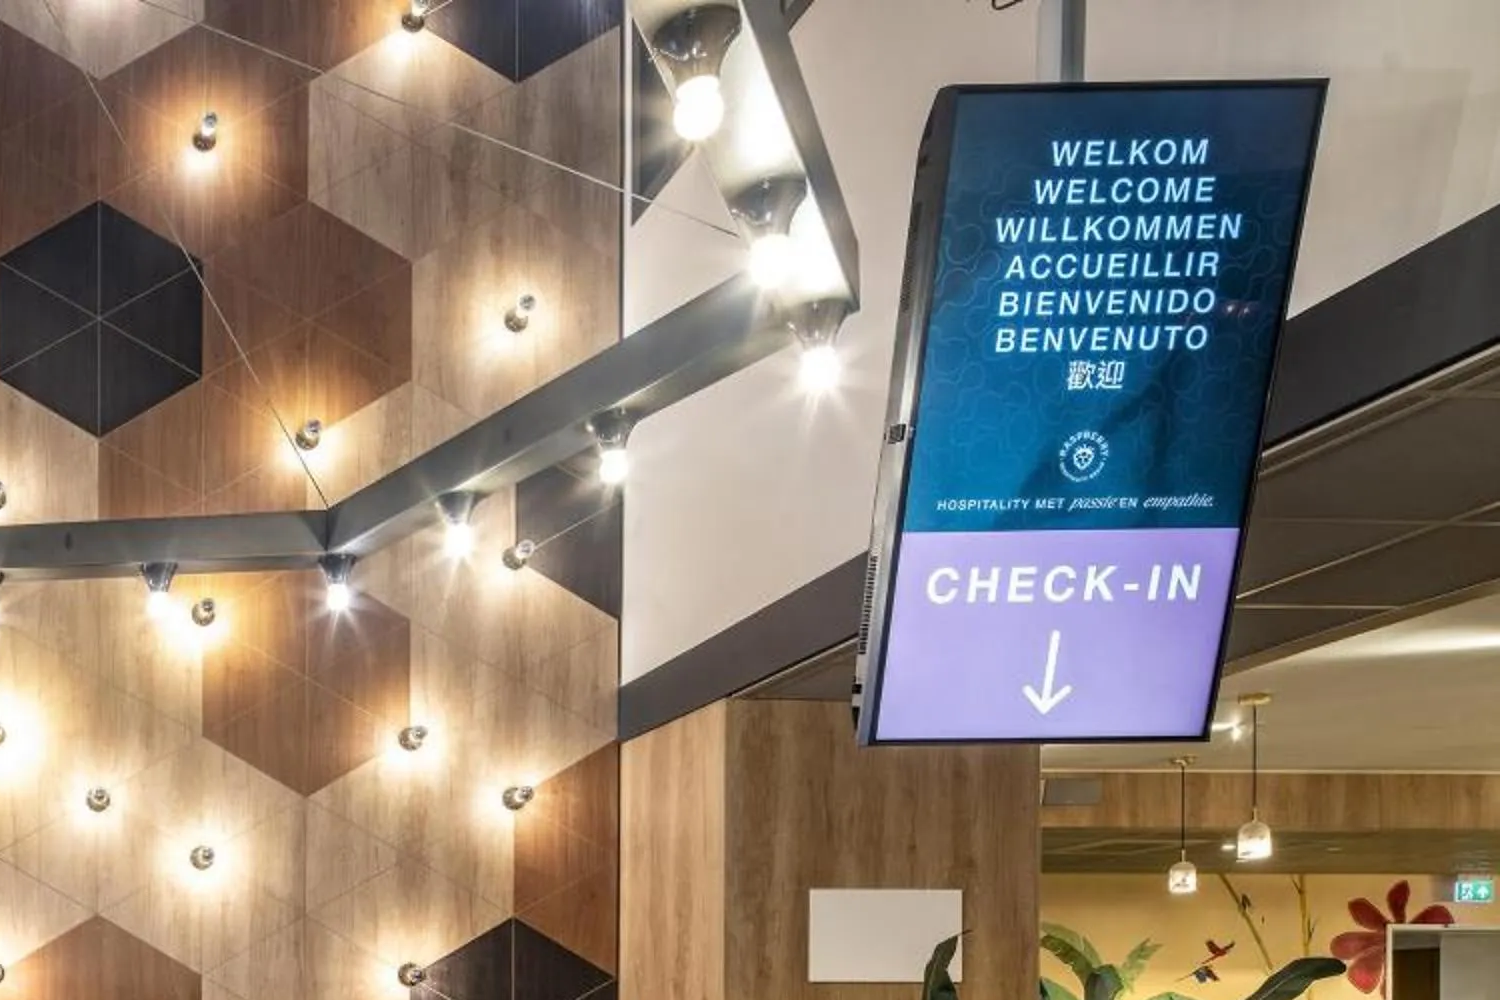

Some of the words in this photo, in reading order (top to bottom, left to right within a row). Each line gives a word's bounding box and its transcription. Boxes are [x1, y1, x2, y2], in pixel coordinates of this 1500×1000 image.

[1051, 139, 1209, 166] WELKOM
[1034, 177, 1216, 204] WELCOME
[995, 214, 1242, 243] WILLKOMMEN
[1005, 252, 1220, 279] ACCUEILLIR
[999, 288, 1215, 317] BIENVENIDO
[995, 325, 1208, 353] BENVENUTO
[1066, 360, 1125, 390] 歡迎
[937, 499, 1029, 511] HOSPITALITY
[1035, 498, 1064, 509] MET
[1119, 498, 1138, 509] EN
[926, 564, 1203, 605] CHECK-IN
